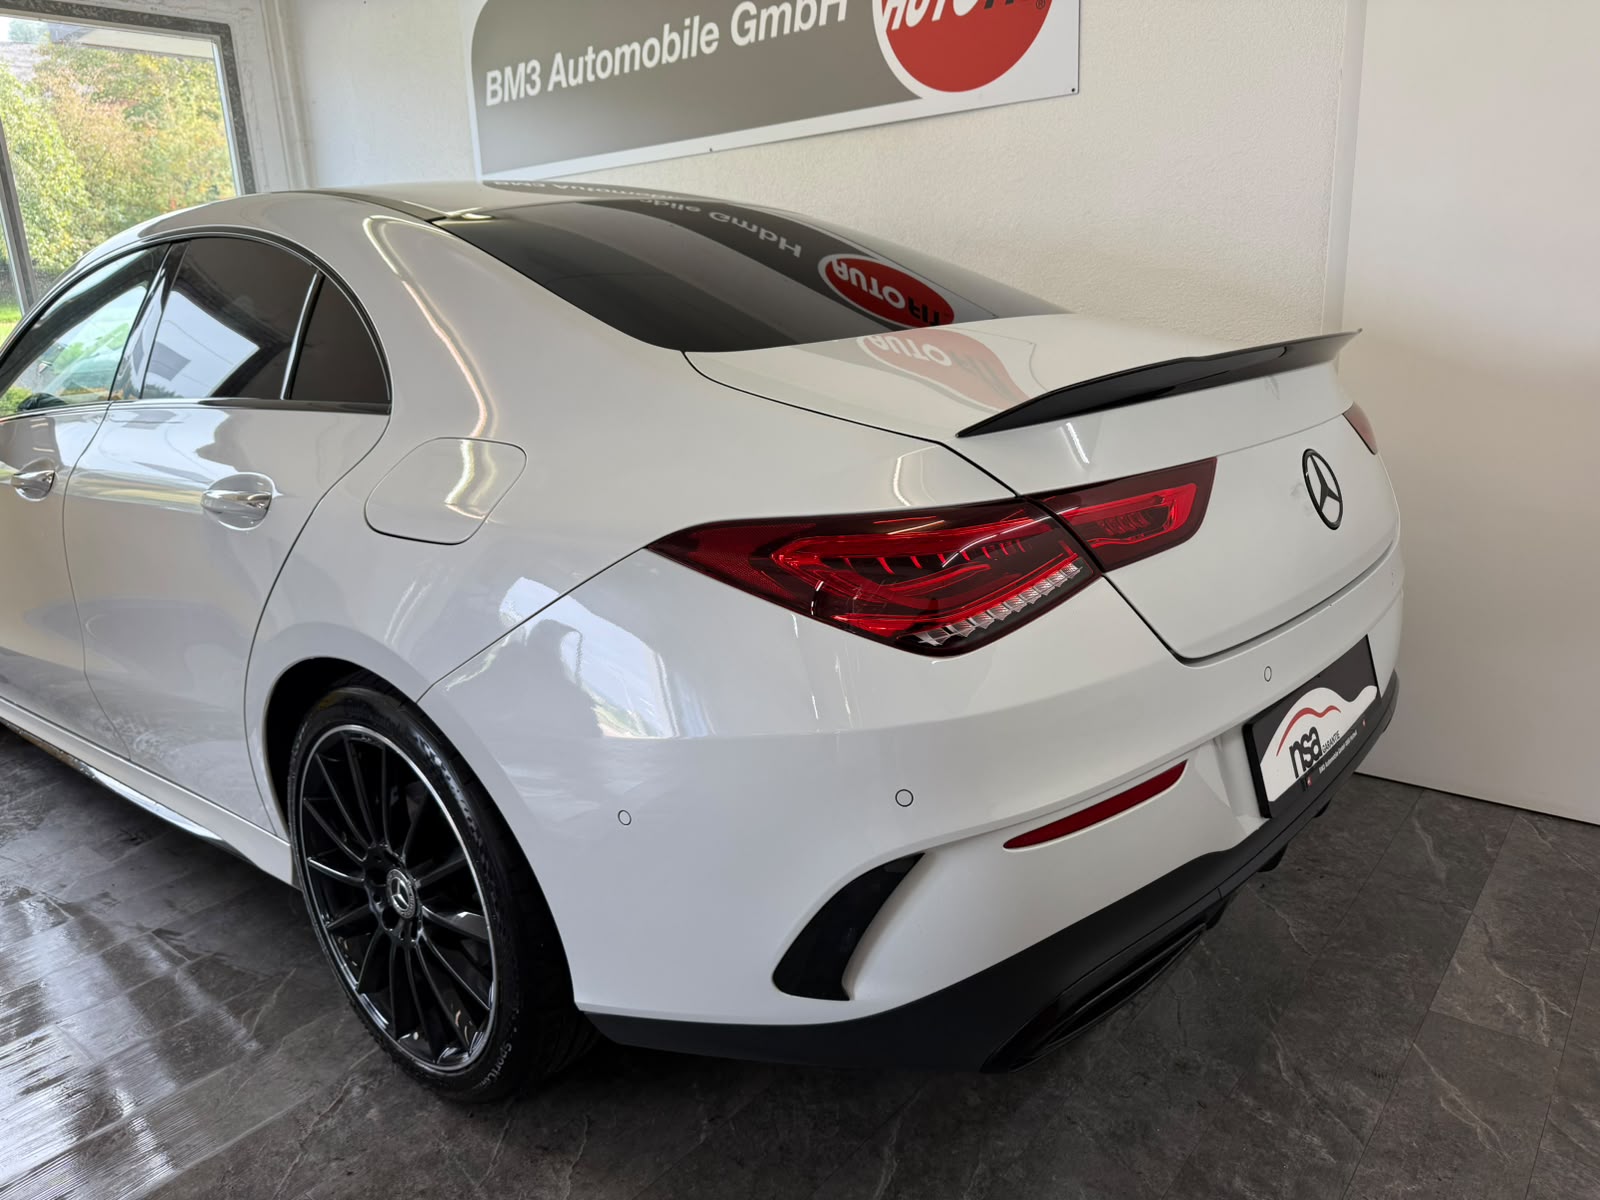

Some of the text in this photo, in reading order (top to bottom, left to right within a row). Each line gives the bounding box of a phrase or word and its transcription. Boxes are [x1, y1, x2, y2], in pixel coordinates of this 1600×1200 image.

[486, 59, 541, 106] BM3
[547, 15, 720, 92] Automobile
[730, 0, 847, 46] GmbH
[1289, 726, 1323, 779] nsa
